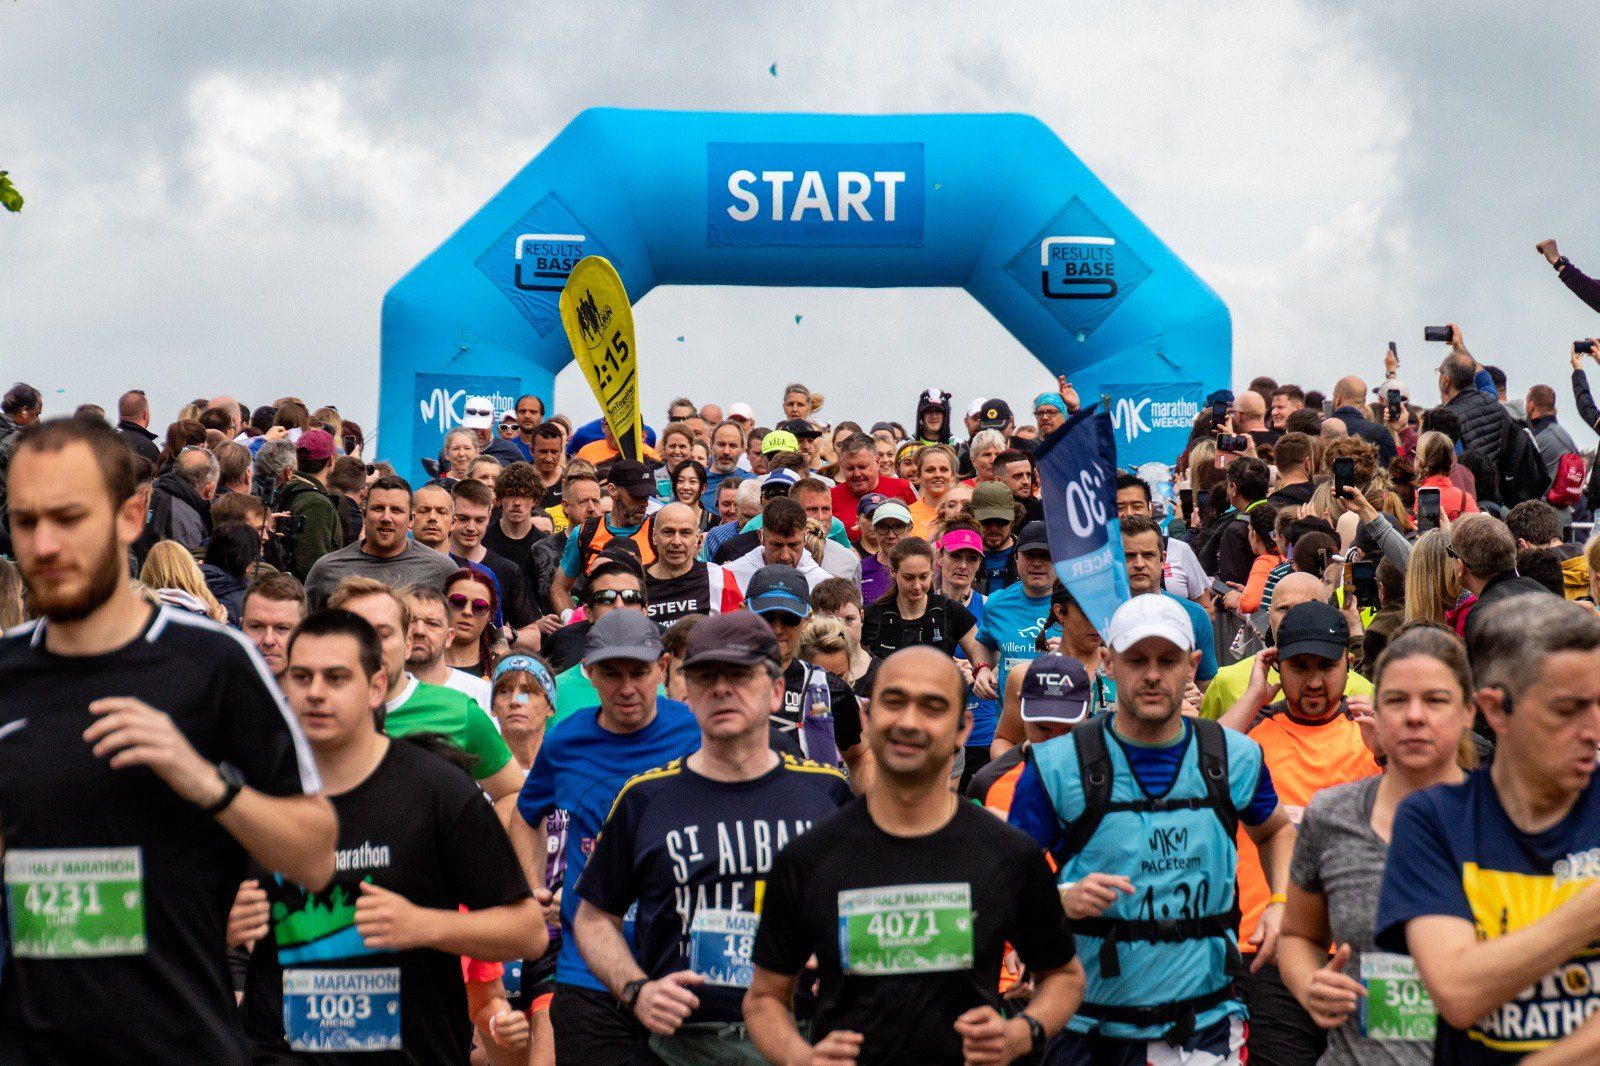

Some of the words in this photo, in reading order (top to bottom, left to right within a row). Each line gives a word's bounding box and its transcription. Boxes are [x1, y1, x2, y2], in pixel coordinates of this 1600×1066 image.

[727, 169, 906, 222] START
[525, 243, 582, 257] RESULTS
[1052, 247, 1114, 260] RESULTS
[1066, 262, 1115, 276] BASE
[420, 388, 466, 434] MK
[1151, 397, 1198, 417] marathon
[1152, 417, 1195, 428] WEEKEN
[647, 599, 698, 617] STEVE
[1036, 673, 1074, 688] TCA
[335, 840, 390, 871] arathon
[717, 820, 812, 875] ALBA
[28, 861, 59, 876] HALF
[62, 859, 136, 876] MARATHON
[24, 881, 103, 915] 4231
[874, 894, 902, 908] HALF
[904, 889, 967, 905] MARATHON
[867, 909, 939, 938] 4071
[313, 974, 398, 991] MARATHON
[306, 993, 371, 1019] 1003
